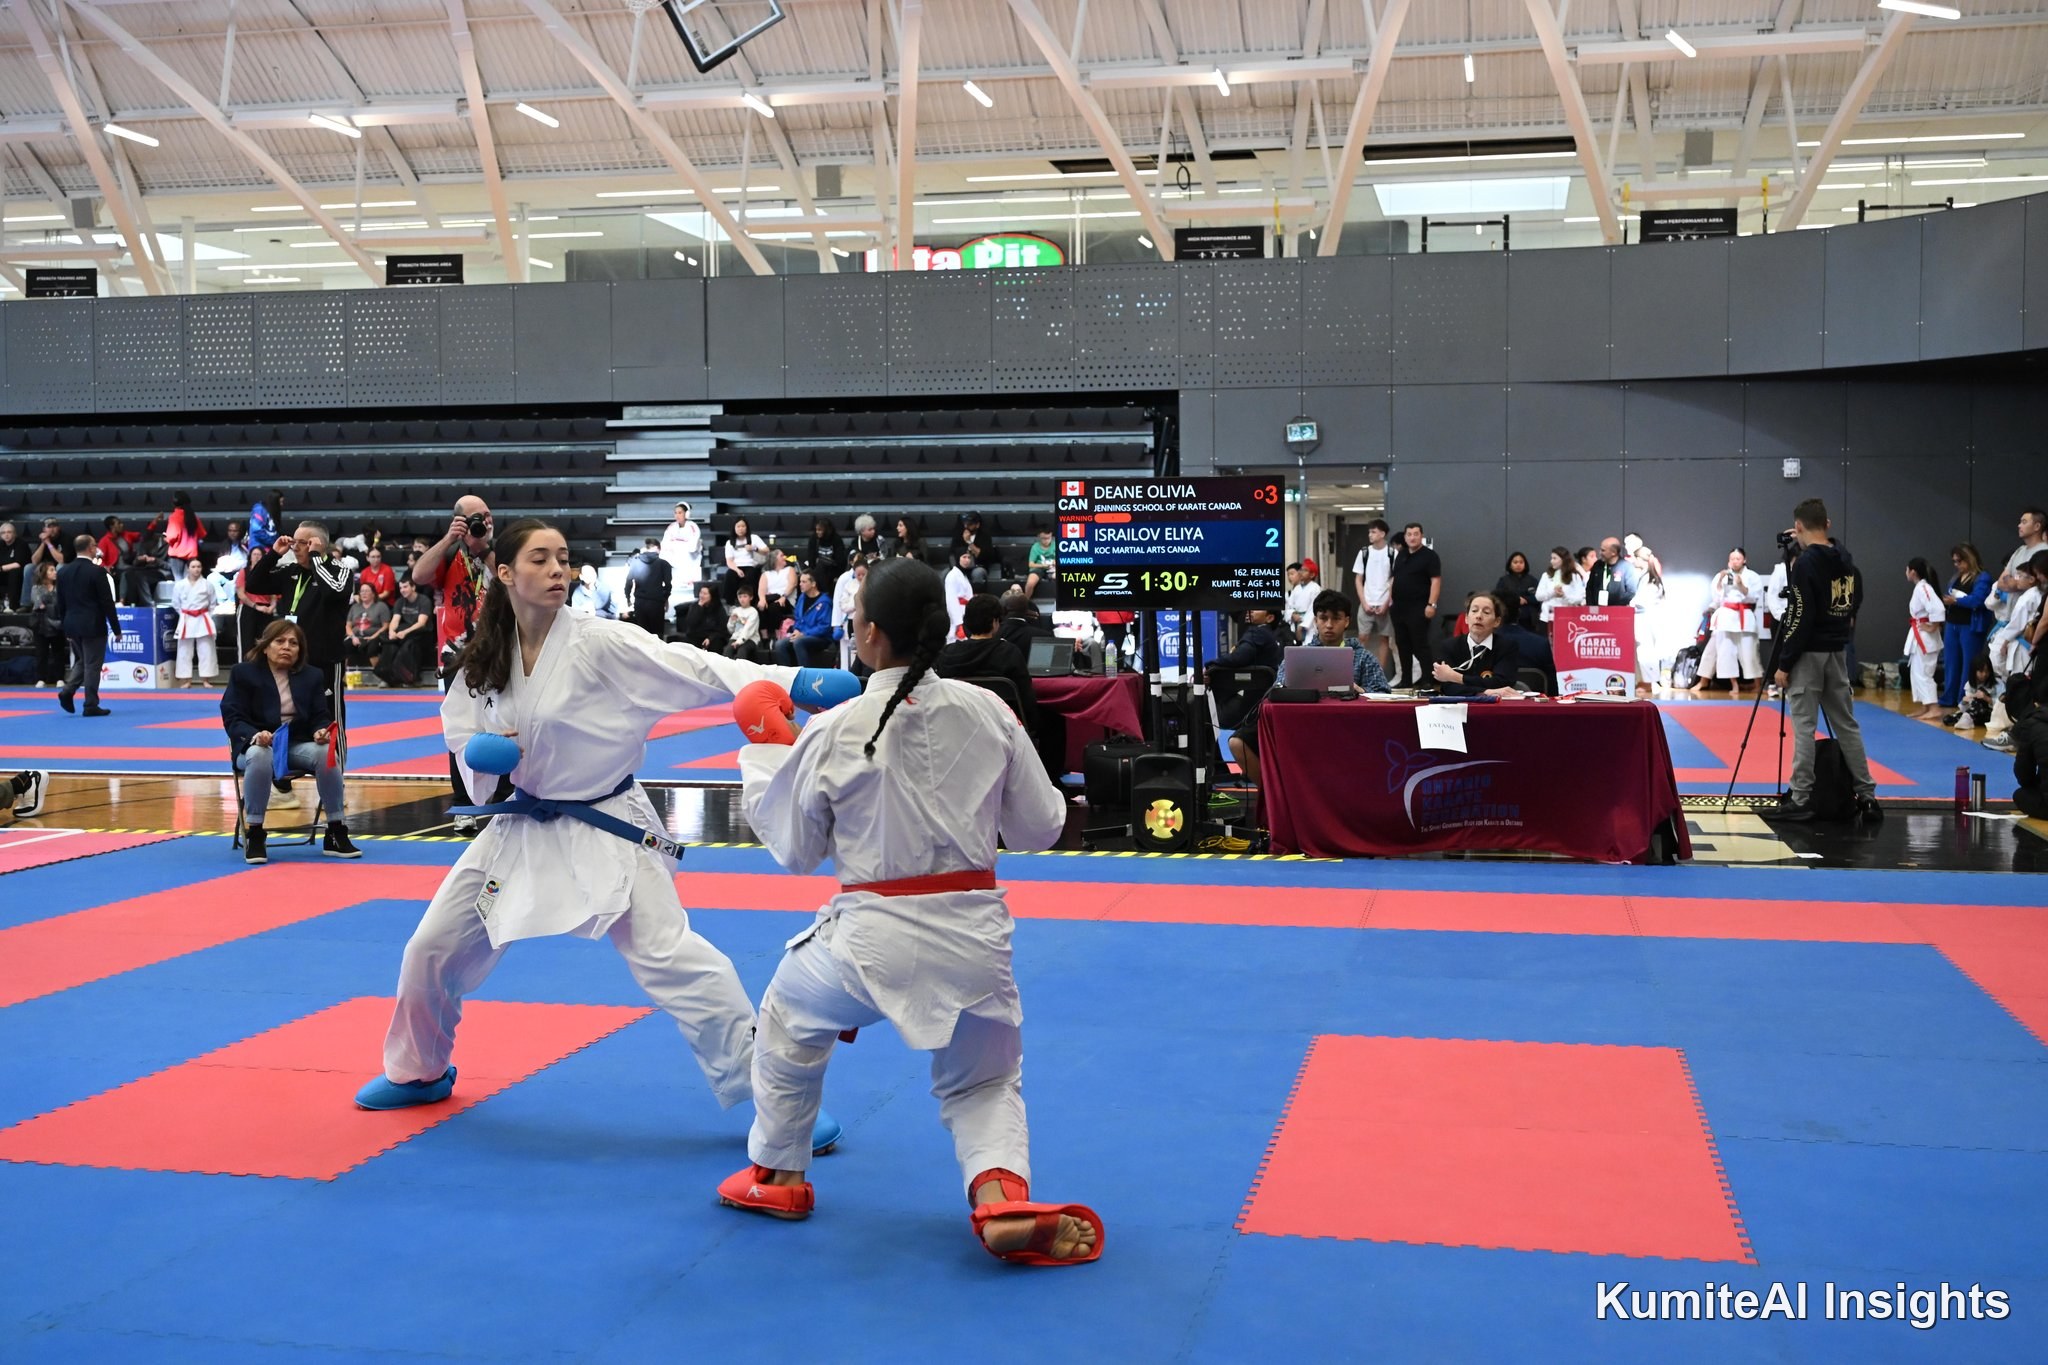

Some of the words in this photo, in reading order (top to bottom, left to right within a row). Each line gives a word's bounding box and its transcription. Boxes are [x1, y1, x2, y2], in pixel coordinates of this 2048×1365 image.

[974, 243, 1040, 269] Pit
[1094, 486, 1143, 499] DEANE
[1147, 484, 1196, 498] OLIVIA
[1058, 499, 1088, 510] CAN
[1094, 504, 1131, 512] JENNINGS
[1208, 502, 1241, 510] CANADA
[1095, 528, 1160, 541] ISRAILOV
[1165, 527, 1204, 540] ELIYA
[1265, 528, 1279, 547] 2
[1059, 540, 1088, 552] CAN
[1250, 568, 1280, 576] FEMALE
[1580, 614, 1609, 622] COACH
[113, 643, 144, 651] ONTARIO
[1580, 638, 1616, 647] KARATE
[1580, 647, 1621, 656] ONTARIO
